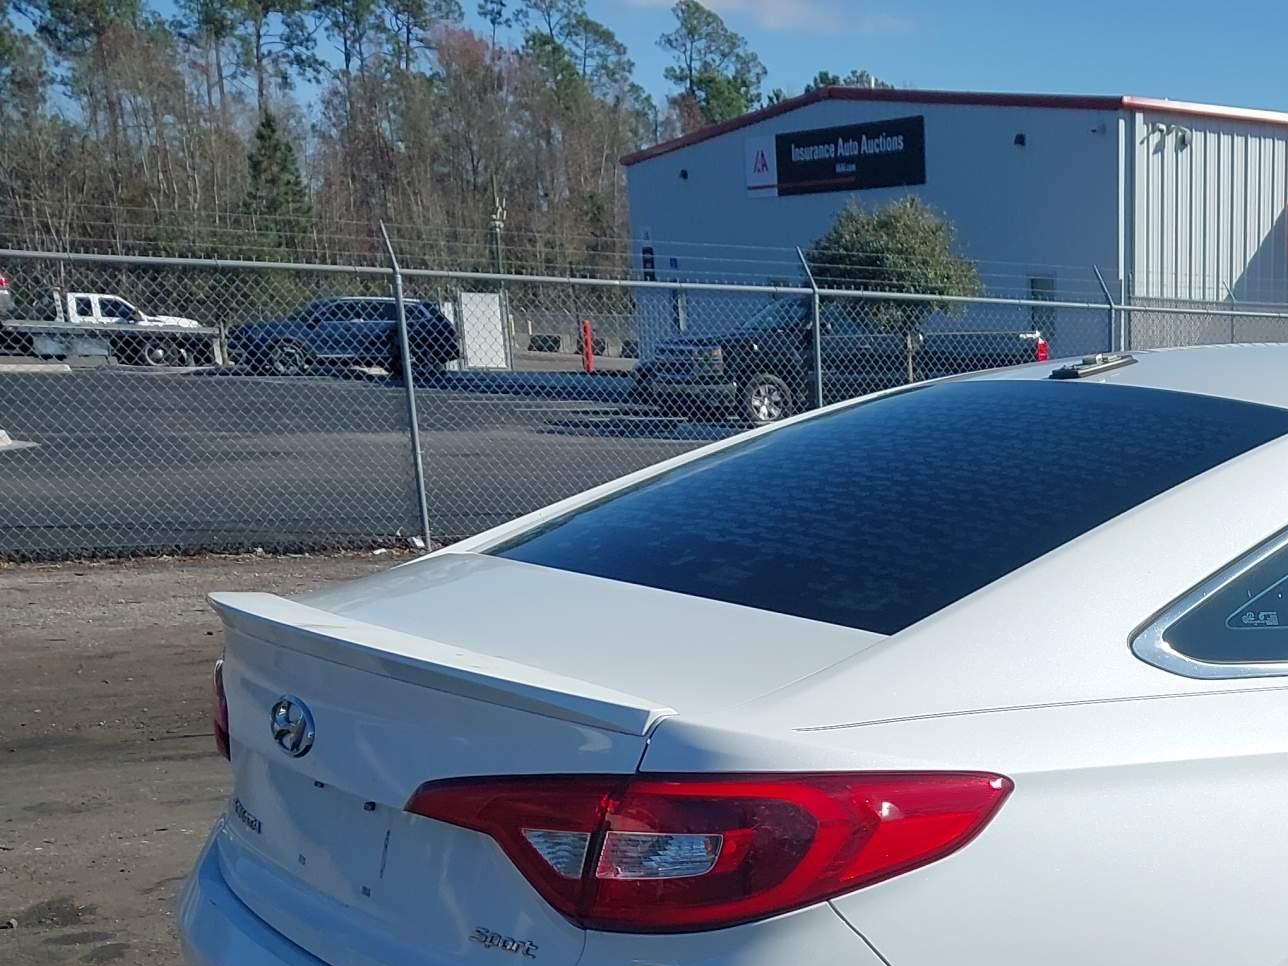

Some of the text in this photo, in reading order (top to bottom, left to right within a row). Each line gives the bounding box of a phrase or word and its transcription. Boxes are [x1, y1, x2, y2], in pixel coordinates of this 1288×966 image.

[791, 132, 904, 161] Insurance Auto Auctions
